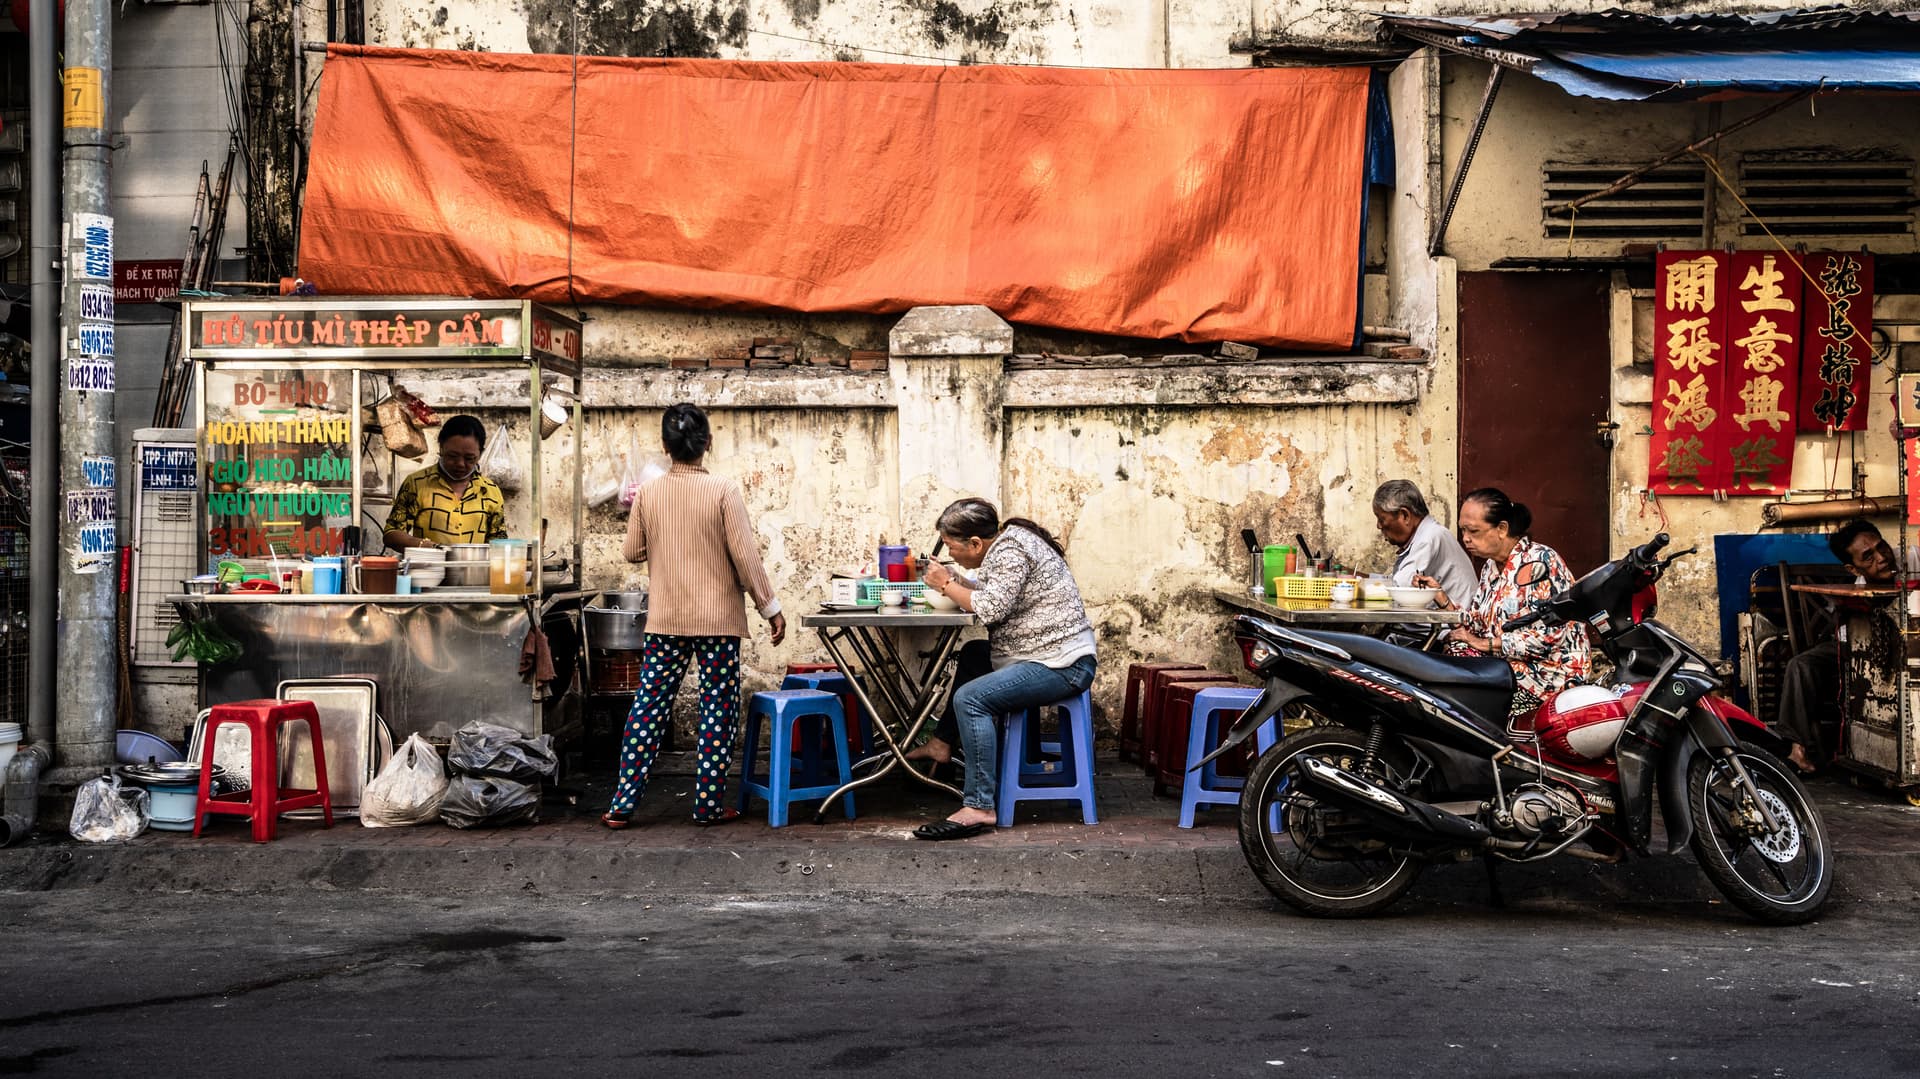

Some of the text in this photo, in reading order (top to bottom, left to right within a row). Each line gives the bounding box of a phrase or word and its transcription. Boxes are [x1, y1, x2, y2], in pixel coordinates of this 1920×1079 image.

[71, 88, 81, 106] 7
[126, 264, 139, 280] ĐỂ
[142, 269, 153, 280] XE
[155, 266, 179, 282] TRẬT
[82, 293, 102, 319] 0934
[204, 311, 504, 347] HỦ TÍU MÌ THẬP CẨM
[1729, 255, 1795, 491] 生意興隆
[182, 474, 197, 486] 13
[254, 493, 275, 522] VỊ
[278, 488, 351, 517] HƯƠNG
[82, 529, 102, 553] 0906
